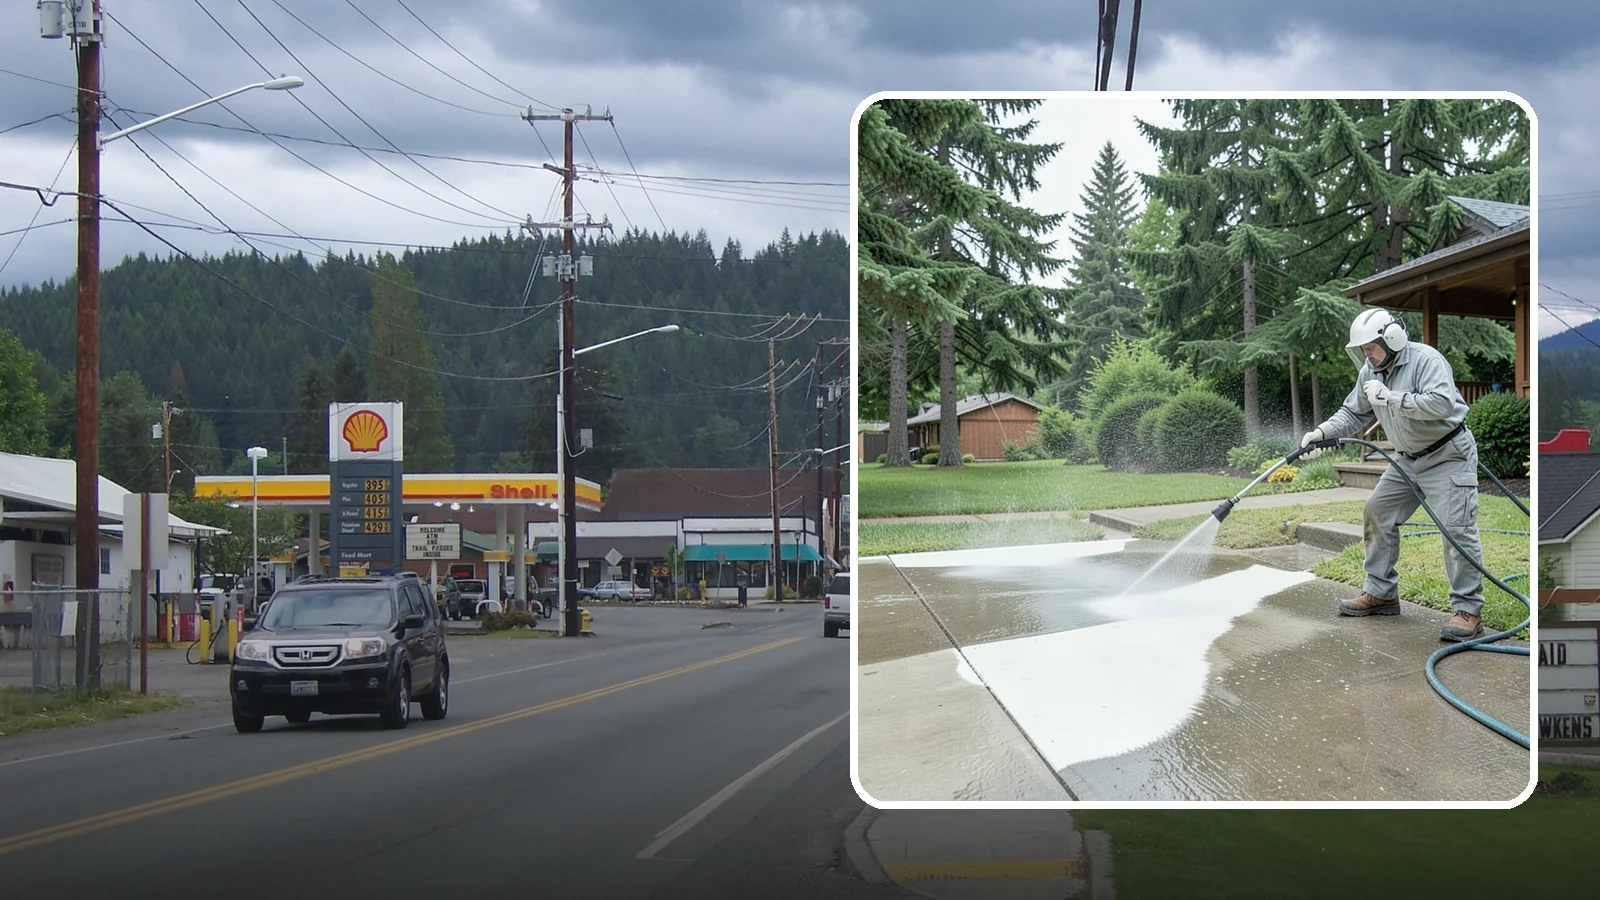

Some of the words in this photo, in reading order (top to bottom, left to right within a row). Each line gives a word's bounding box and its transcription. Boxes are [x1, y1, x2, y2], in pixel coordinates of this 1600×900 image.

[366, 480, 383, 490] 395
[490, 484, 547, 499] Shell
[366, 494, 383, 504] 405
[366, 508, 383, 518] 415
[366, 522, 383, 532] 429
